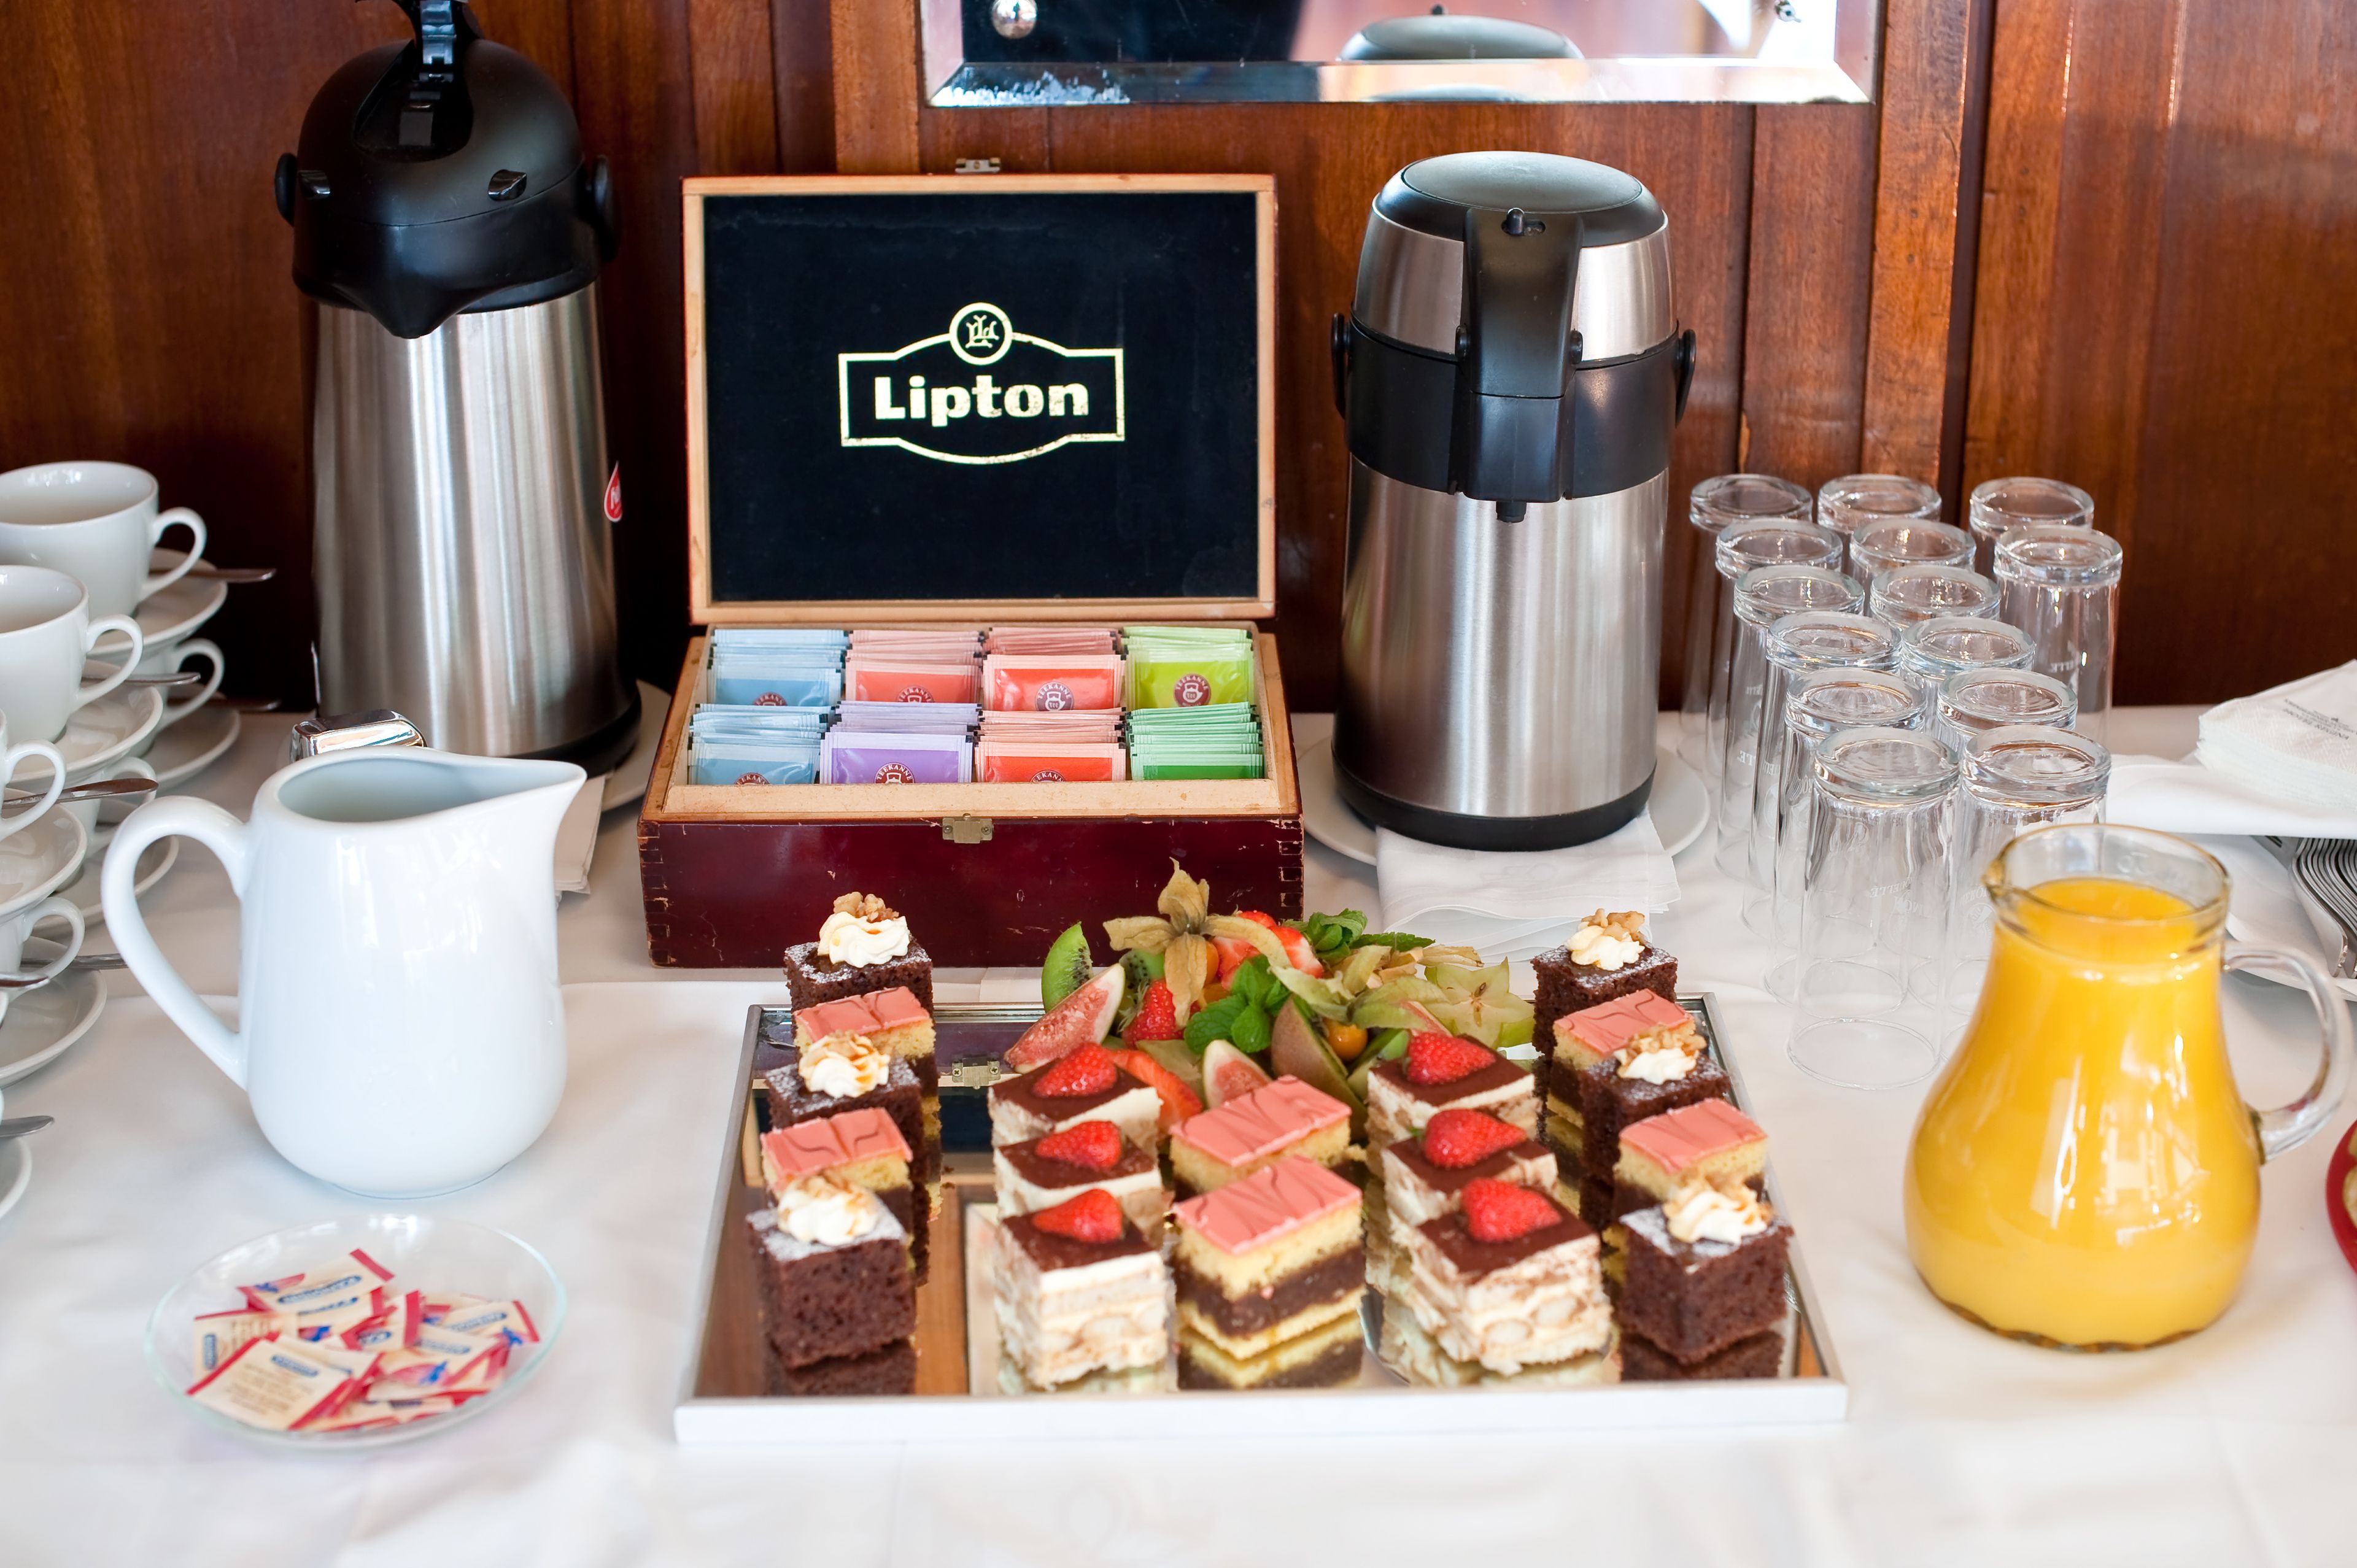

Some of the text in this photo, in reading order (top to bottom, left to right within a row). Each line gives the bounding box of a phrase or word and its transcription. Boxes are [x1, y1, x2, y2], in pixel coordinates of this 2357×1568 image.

[875, 375, 1088, 427] Lipton
[1037, 684, 1071, 699] TEEKANNE
[877, 765, 913, 781] TEEKANNE
